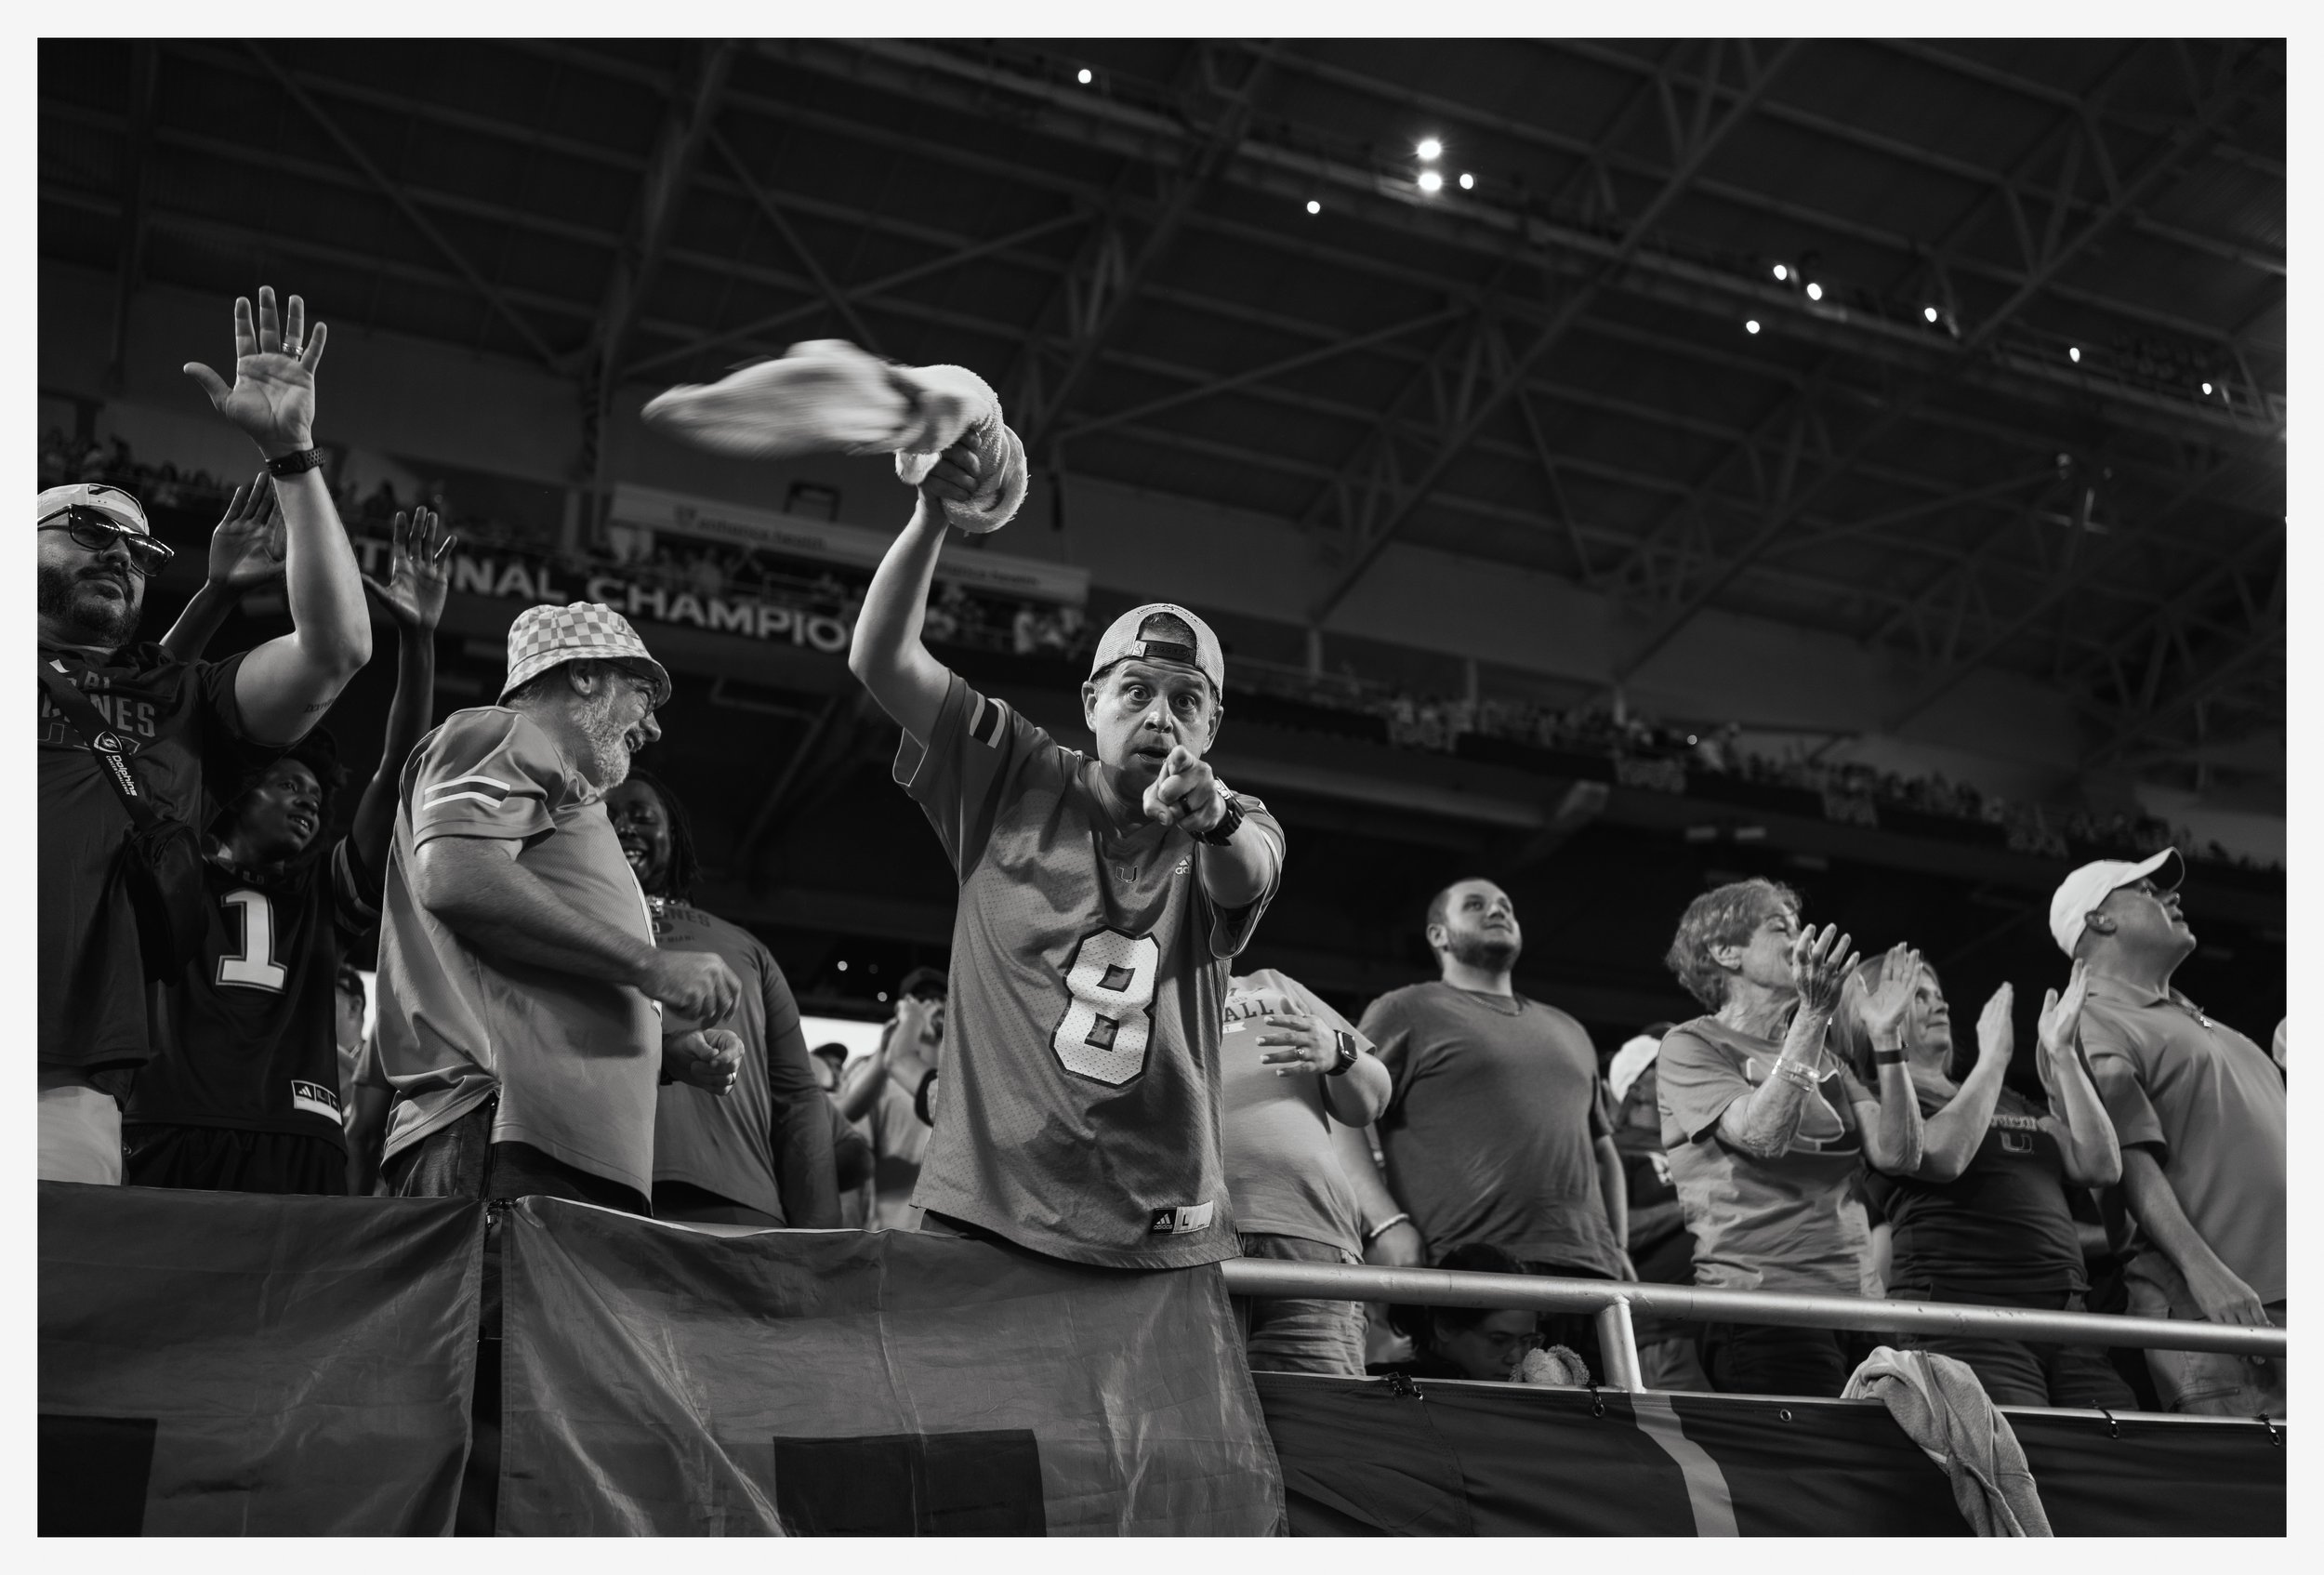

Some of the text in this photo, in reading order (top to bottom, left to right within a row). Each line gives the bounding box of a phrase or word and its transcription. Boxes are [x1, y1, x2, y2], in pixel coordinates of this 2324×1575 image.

[112, 755, 138, 797] Dolphins
[216, 887, 287, 995] 1
[1050, 924, 1161, 1090] 8
